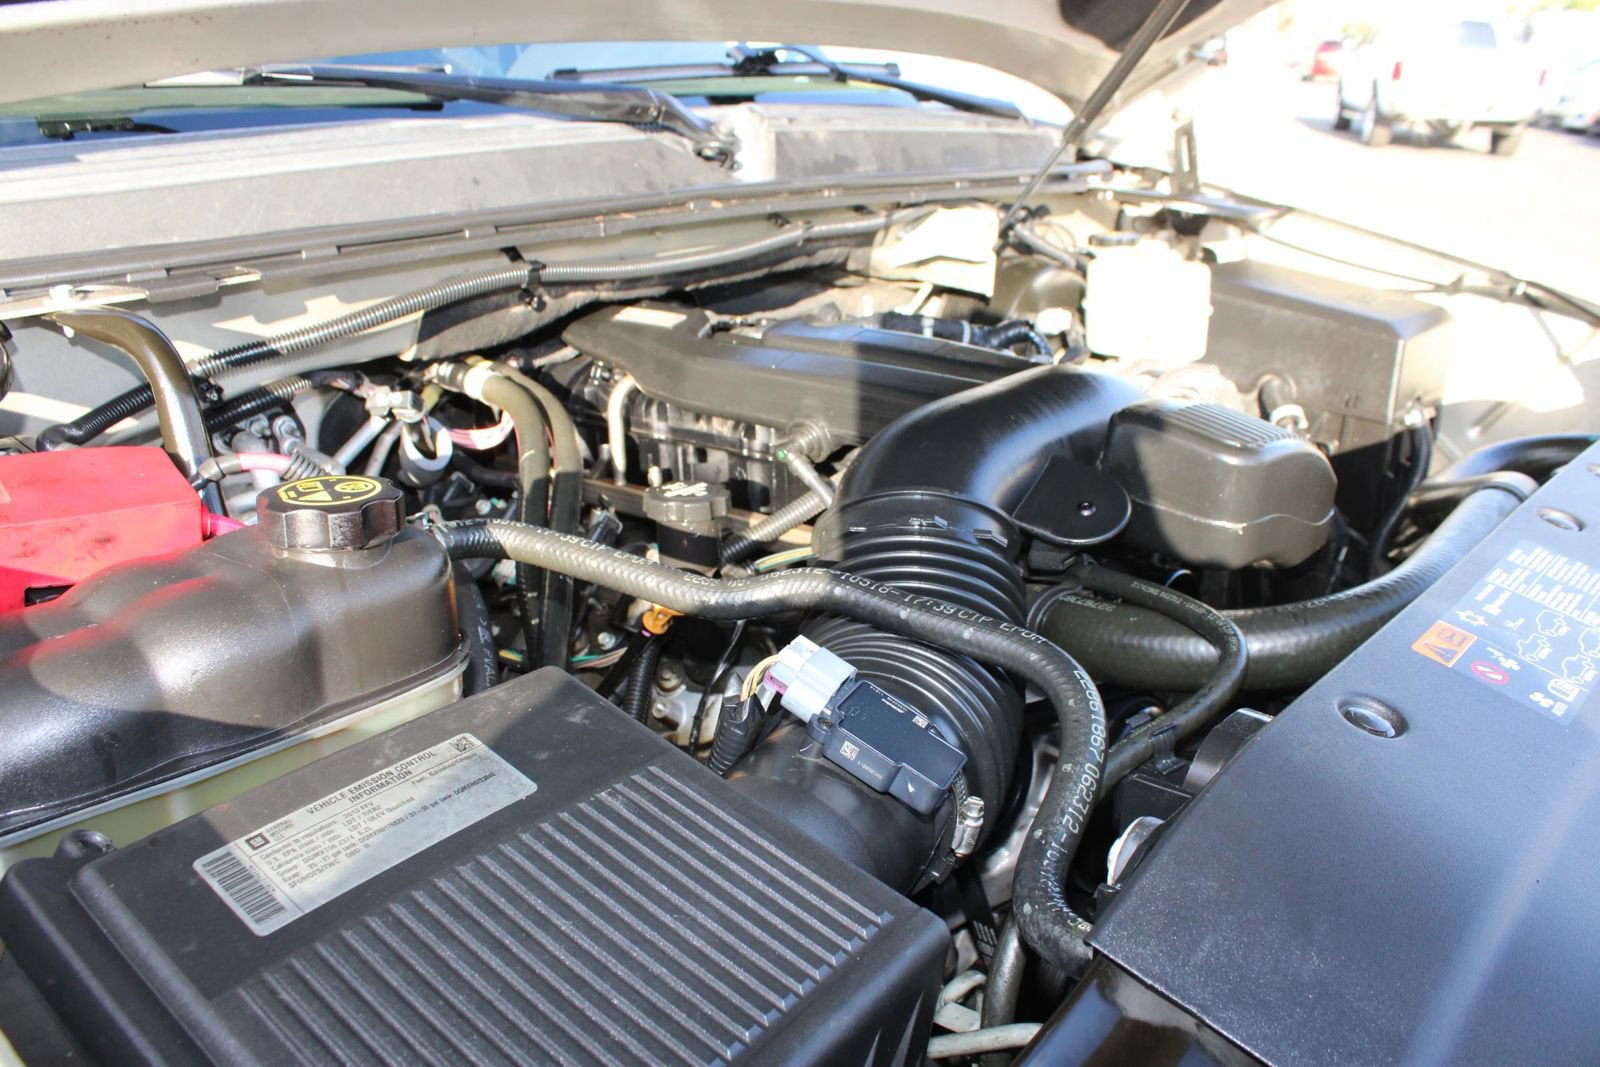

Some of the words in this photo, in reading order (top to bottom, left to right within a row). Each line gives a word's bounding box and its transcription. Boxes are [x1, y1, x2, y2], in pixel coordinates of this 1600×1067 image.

[1073, 670, 1106, 765] 22861867
[305, 791, 349, 815] VEHICLE
[347, 769, 395, 795] EMISSION
[393, 749, 437, 772] CONTROL
[347, 768, 414, 803] INFORMATION
